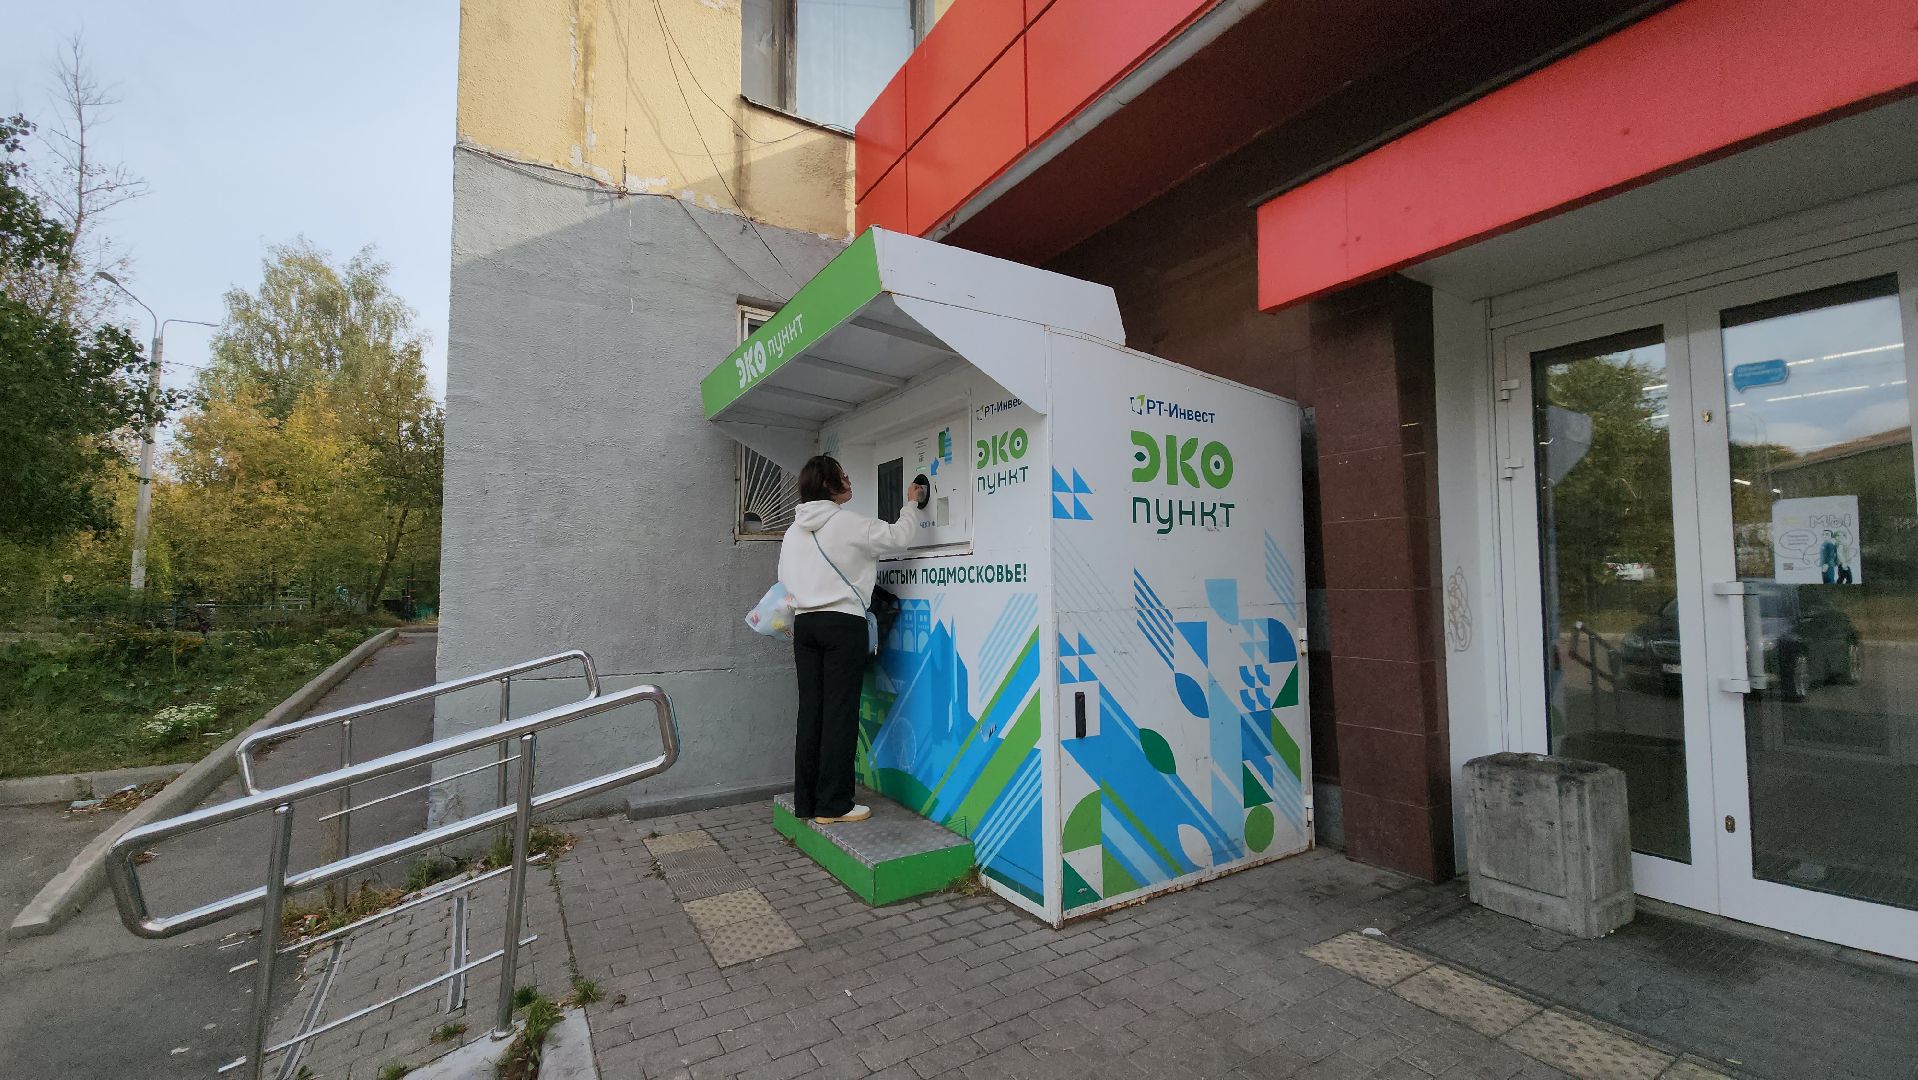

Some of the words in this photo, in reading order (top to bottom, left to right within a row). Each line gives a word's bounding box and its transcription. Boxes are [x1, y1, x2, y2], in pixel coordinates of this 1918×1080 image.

[736, 341, 766, 388] ЭКО
[984, 398, 1022, 417] РТ-Инвес
[1146, 399, 1215, 423] РТ-Инвест
[977, 427, 1028, 469] ЭКО
[1130, 430, 1234, 489] ЭКО
[876, 568, 917, 585] ЧИСТЫМ
[921, 563, 1027, 586] ПОДМОСКОВЬЕ!
